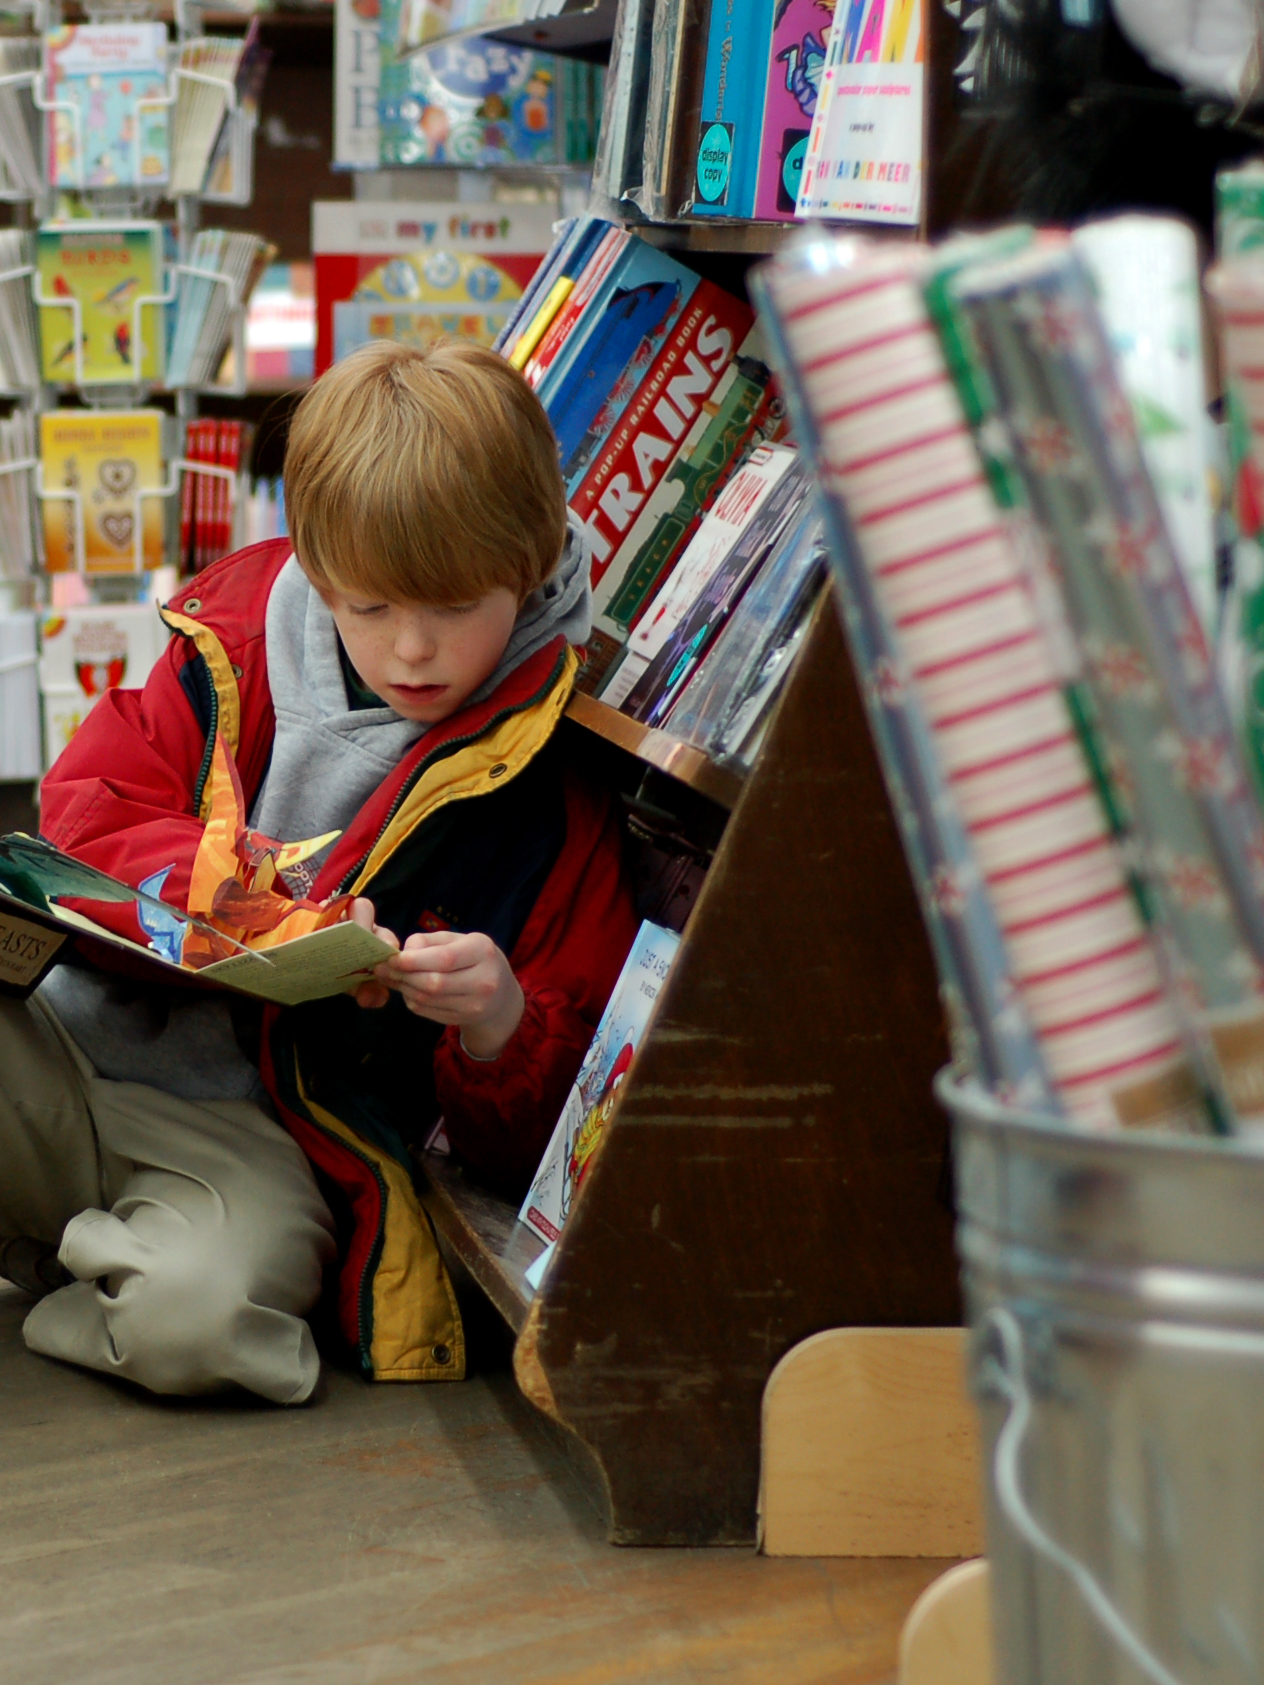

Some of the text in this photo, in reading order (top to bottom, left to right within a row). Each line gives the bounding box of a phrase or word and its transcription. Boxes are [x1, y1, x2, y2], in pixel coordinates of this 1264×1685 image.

[702, 147, 729, 165] display
[703, 168, 723, 183] copy
[852, 161, 874, 182] DER
[876, 162, 910, 184] MEER
[396, 219, 438, 246] my
[448, 214, 511, 240] first
[594, 427, 629, 484] POP-UP
[629, 350, 677, 425] RAILROAD
[675, 306, 703, 346] BOOK
